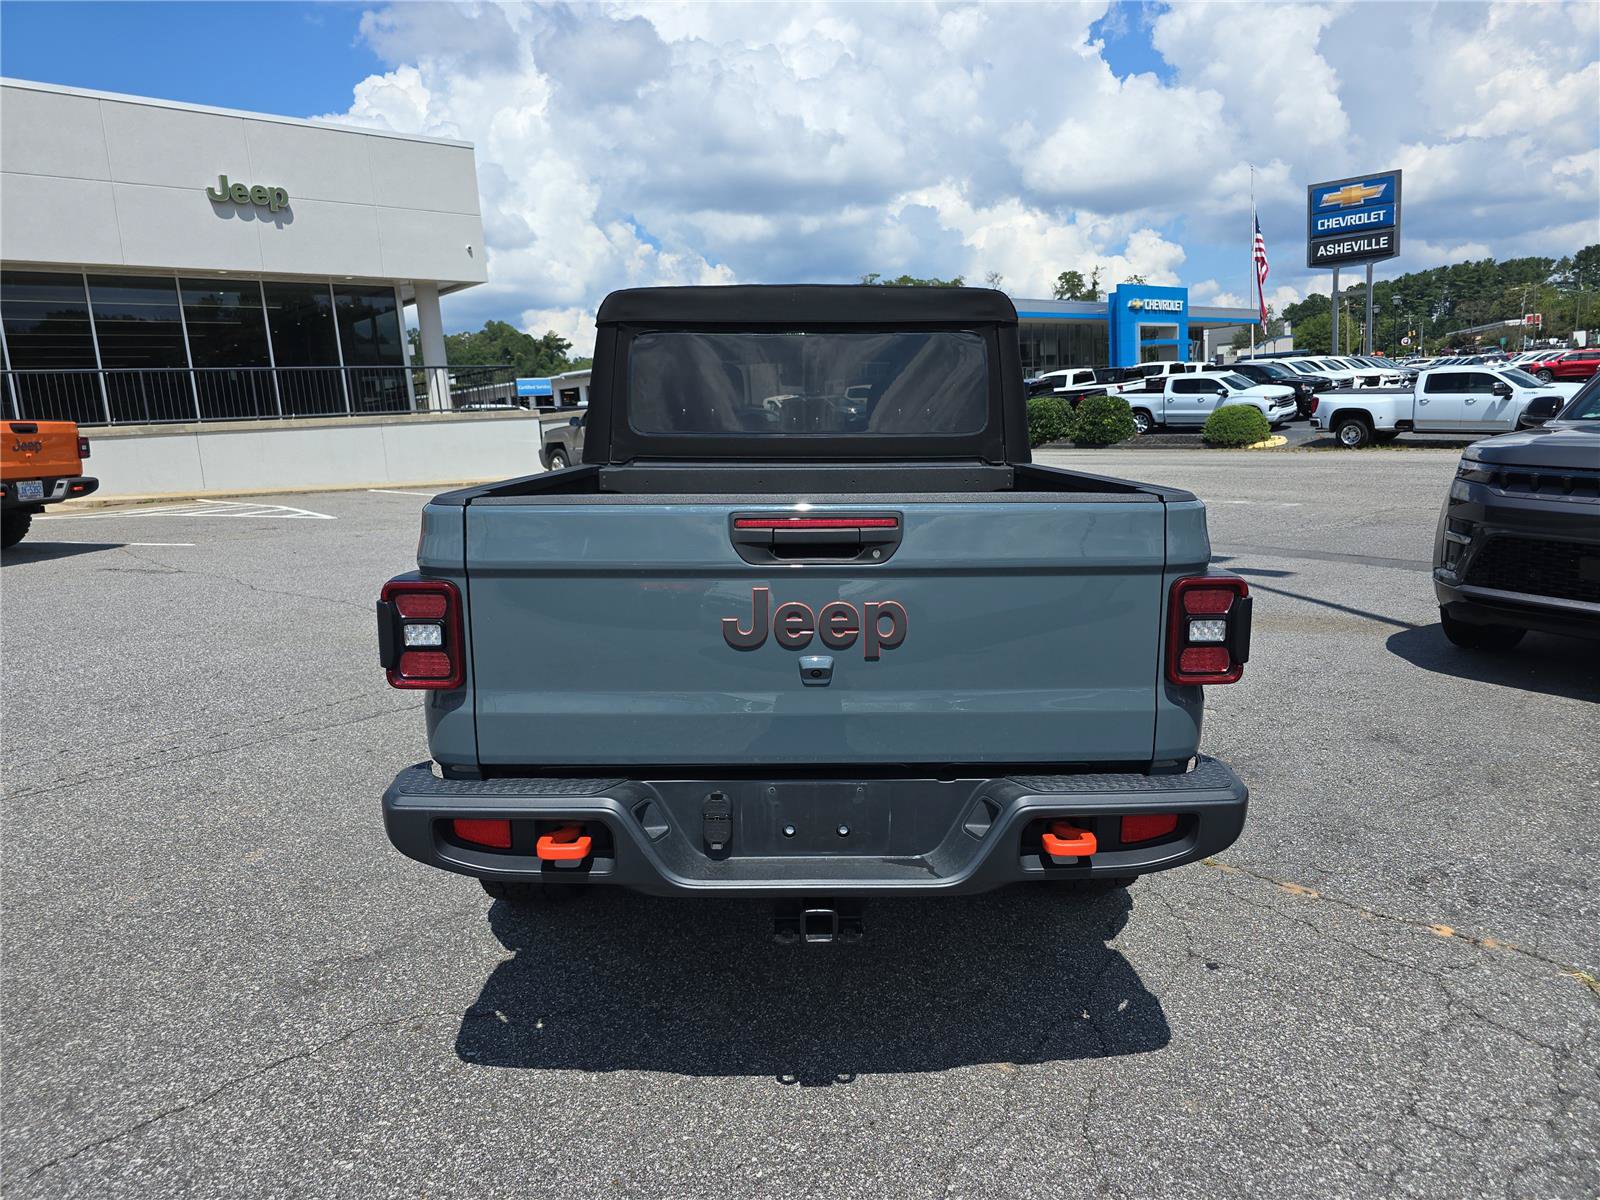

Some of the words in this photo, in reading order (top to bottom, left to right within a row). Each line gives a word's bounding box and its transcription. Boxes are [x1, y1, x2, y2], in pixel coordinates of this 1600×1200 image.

[206, 174, 289, 212] Jeep
[1317, 210, 1386, 230] CHEVROLET
[1317, 236, 1389, 257] ASHEVILLE
[1144, 299, 1184, 311] CHEVROLET
[12, 438, 42, 454] Jeep
[721, 587, 908, 661] Jeep
